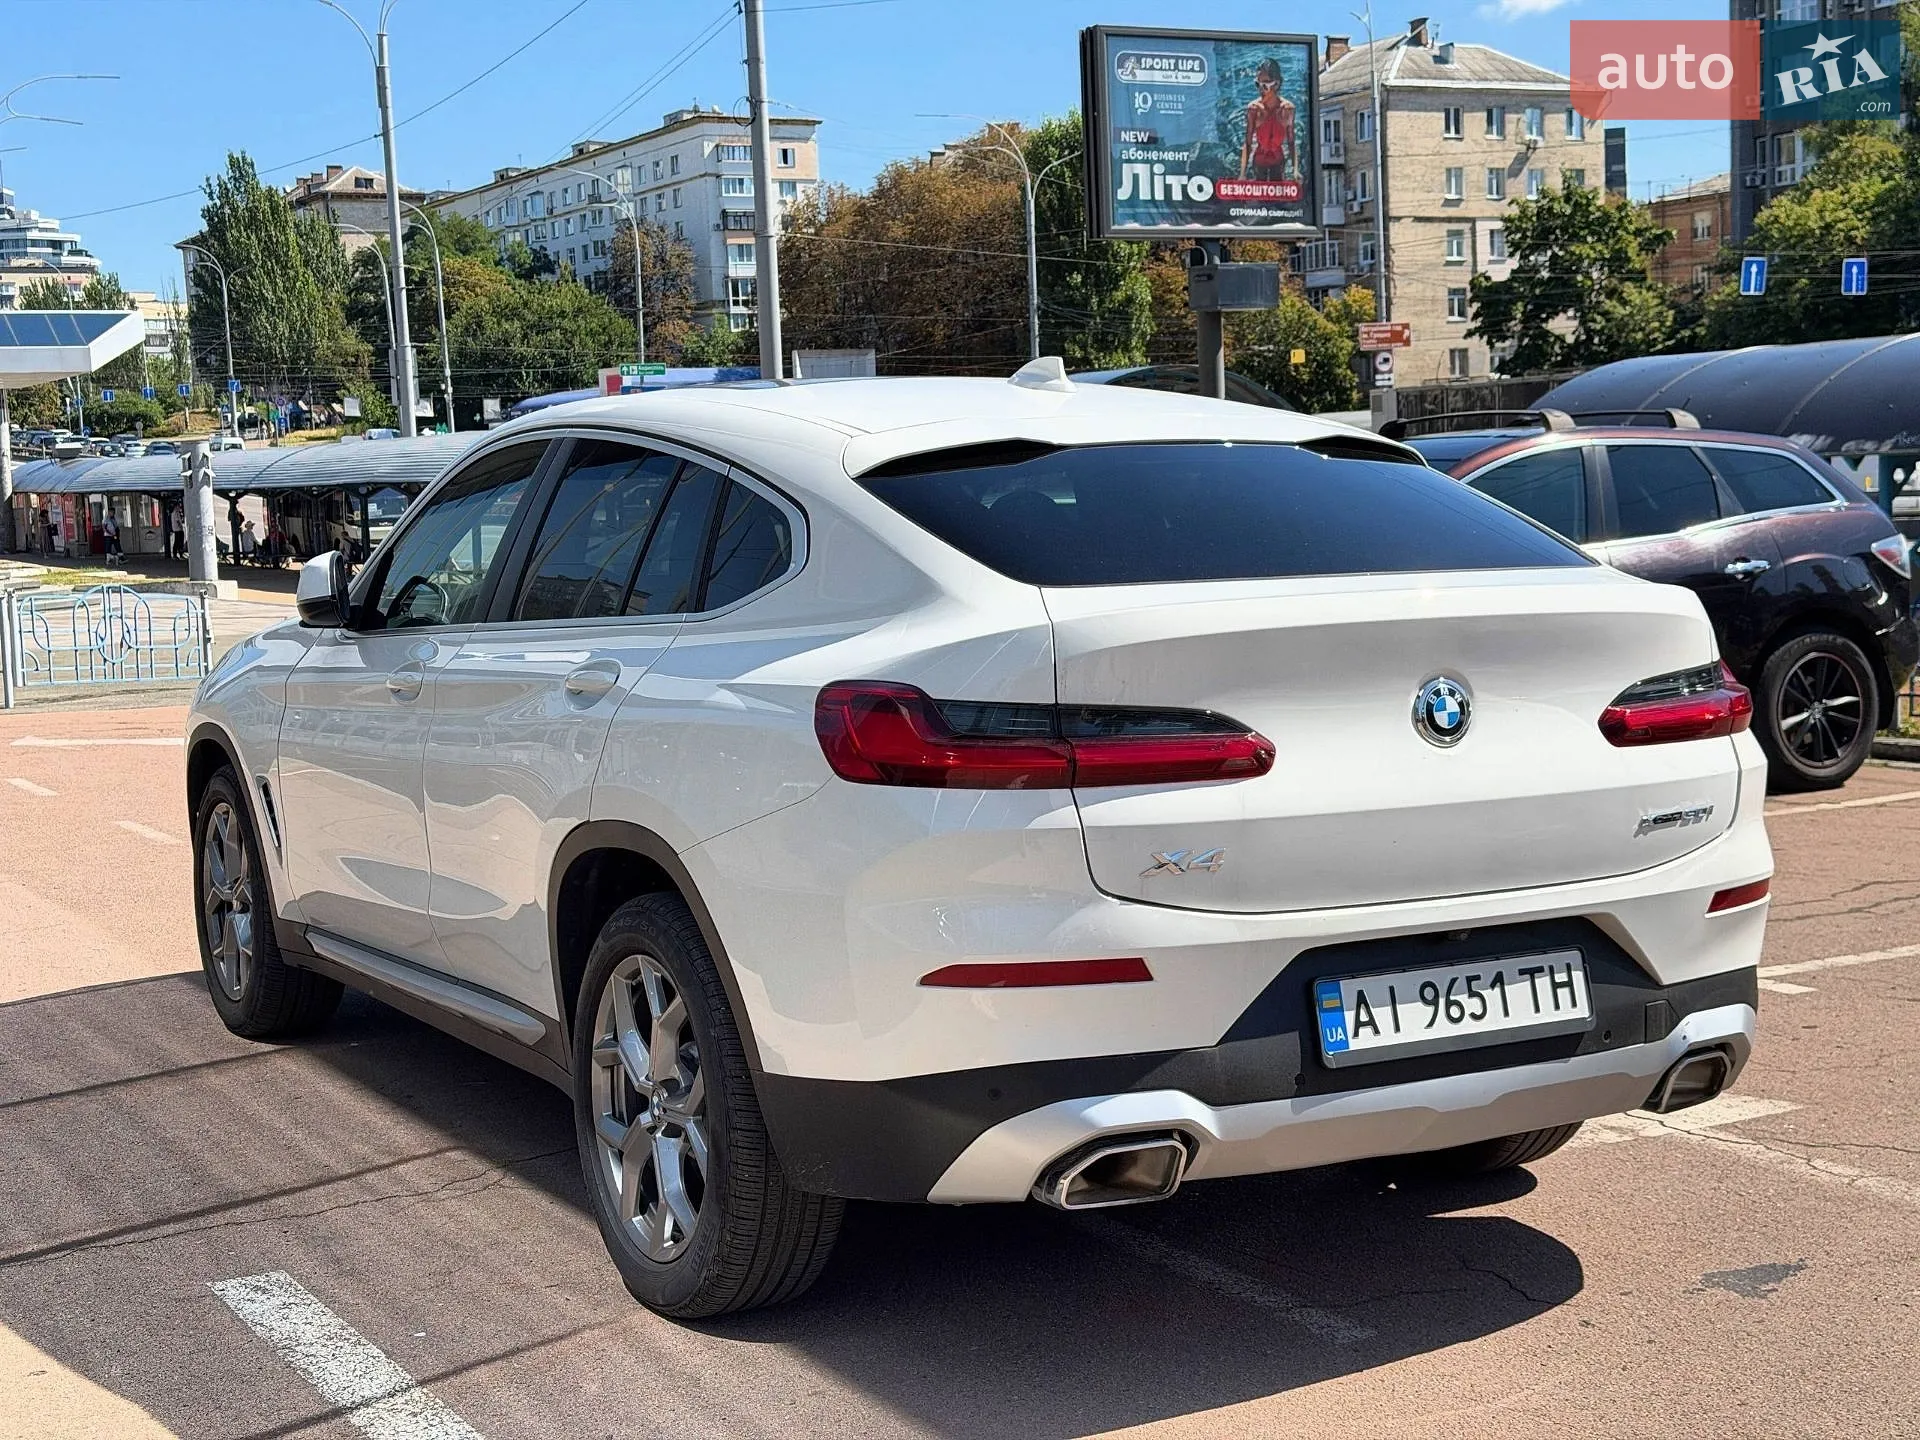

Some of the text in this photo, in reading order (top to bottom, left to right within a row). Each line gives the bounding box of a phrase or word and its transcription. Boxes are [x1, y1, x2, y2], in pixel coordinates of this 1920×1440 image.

[1140, 57, 1201, 71] SPORT LIFE
[1120, 130, 1149, 143] NEW
[1121, 147, 1190, 161] абонемент
[1117, 162, 1214, 202] Літо
[1220, 183, 1298, 197] БЕЗКОШТОВНО
[1229, 207, 1268, 217] ОТРИМАЙ
[1428, 686, 1463, 705] BMW
[1138, 847, 1227, 877] X4
[1352, 962, 1579, 1039] AI 9651 TH
[1326, 1027, 1347, 1043] UA
